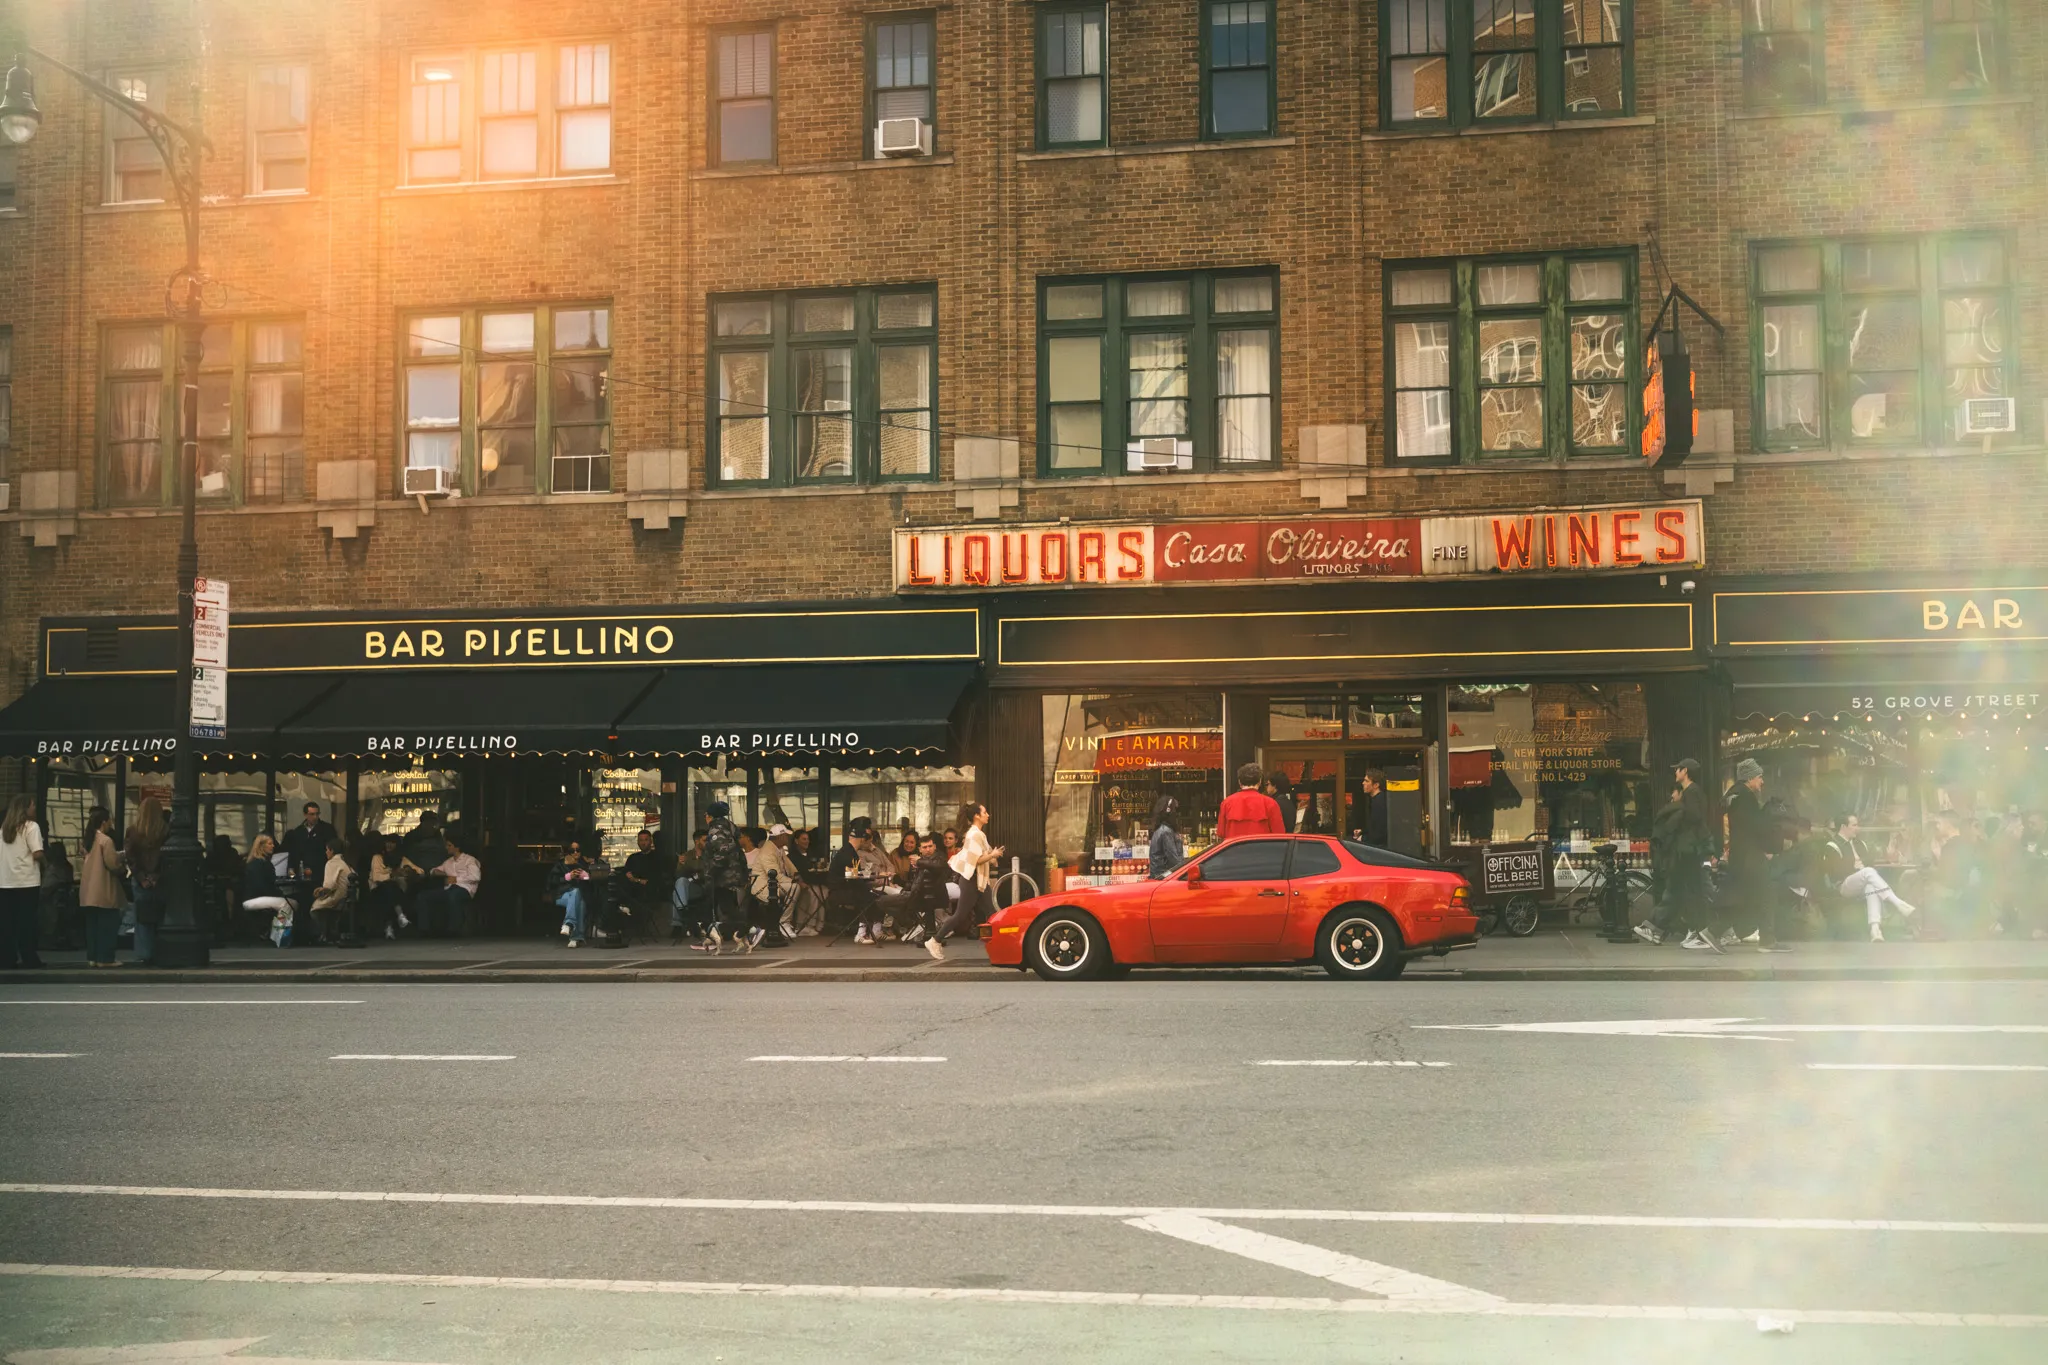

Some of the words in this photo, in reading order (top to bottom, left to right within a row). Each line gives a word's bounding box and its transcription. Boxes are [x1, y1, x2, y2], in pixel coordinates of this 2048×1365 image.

[1432, 545, 1468, 561] FINE
[1492, 509, 1686, 571] WINES
[909, 531, 1144, 586] LIQUORS
[1164, 531, 1247, 578] Casa
[1267, 527, 1411, 575] Oliveira
[1302, 563, 1362, 575] LIQUORS
[197, 608, 203, 619] 2
[1922, 598, 2023, 630] BAR
[196, 623, 221, 631] COMMERCIAL
[365, 630, 445, 659] BAR
[465, 625, 674, 657] PISELLINO
[195, 668, 201, 680] 2
[1852, 697, 1874, 709] 52
[1885, 696, 1954, 709] GROVE
[1964, 694, 2040, 707] STREET
[37, 740, 73, 753] BAR
[82, 738, 177, 752] PISELLINO
[367, 737, 405, 750] BAR
[416, 735, 517, 749] PISELLINO
[701, 734, 741, 748] BAR
[752, 732, 859, 747] PISELLINO
[1065, 736, 1106, 751] VINI
[1117, 739, 1123, 750] E
[1132, 735, 1197, 750] AMARI
[1494, 729, 1549, 749] Officina
[1554, 727, 1576, 743] del
[1579, 728, 1612, 743] Bere
[1514, 749, 1535, 758] NEW
[1539, 748, 1564, 757] YORK
[1566, 747, 1594, 757] STATE
[1488, 761, 1520, 771] RETAIL
[1522, 760, 1544, 770] WINE
[1546, 760, 1553, 770] &
[1554, 760, 1588, 770] LIQUOR
[1591, 759, 1621, 769] STORE
[603, 769, 639, 778] Cocktail
[411, 783, 432, 792] BIRRA
[1487, 855, 1538, 872] OFFICINA
[1489, 873, 1510, 883] DEL
[1511, 870, 1539, 881] BERE
